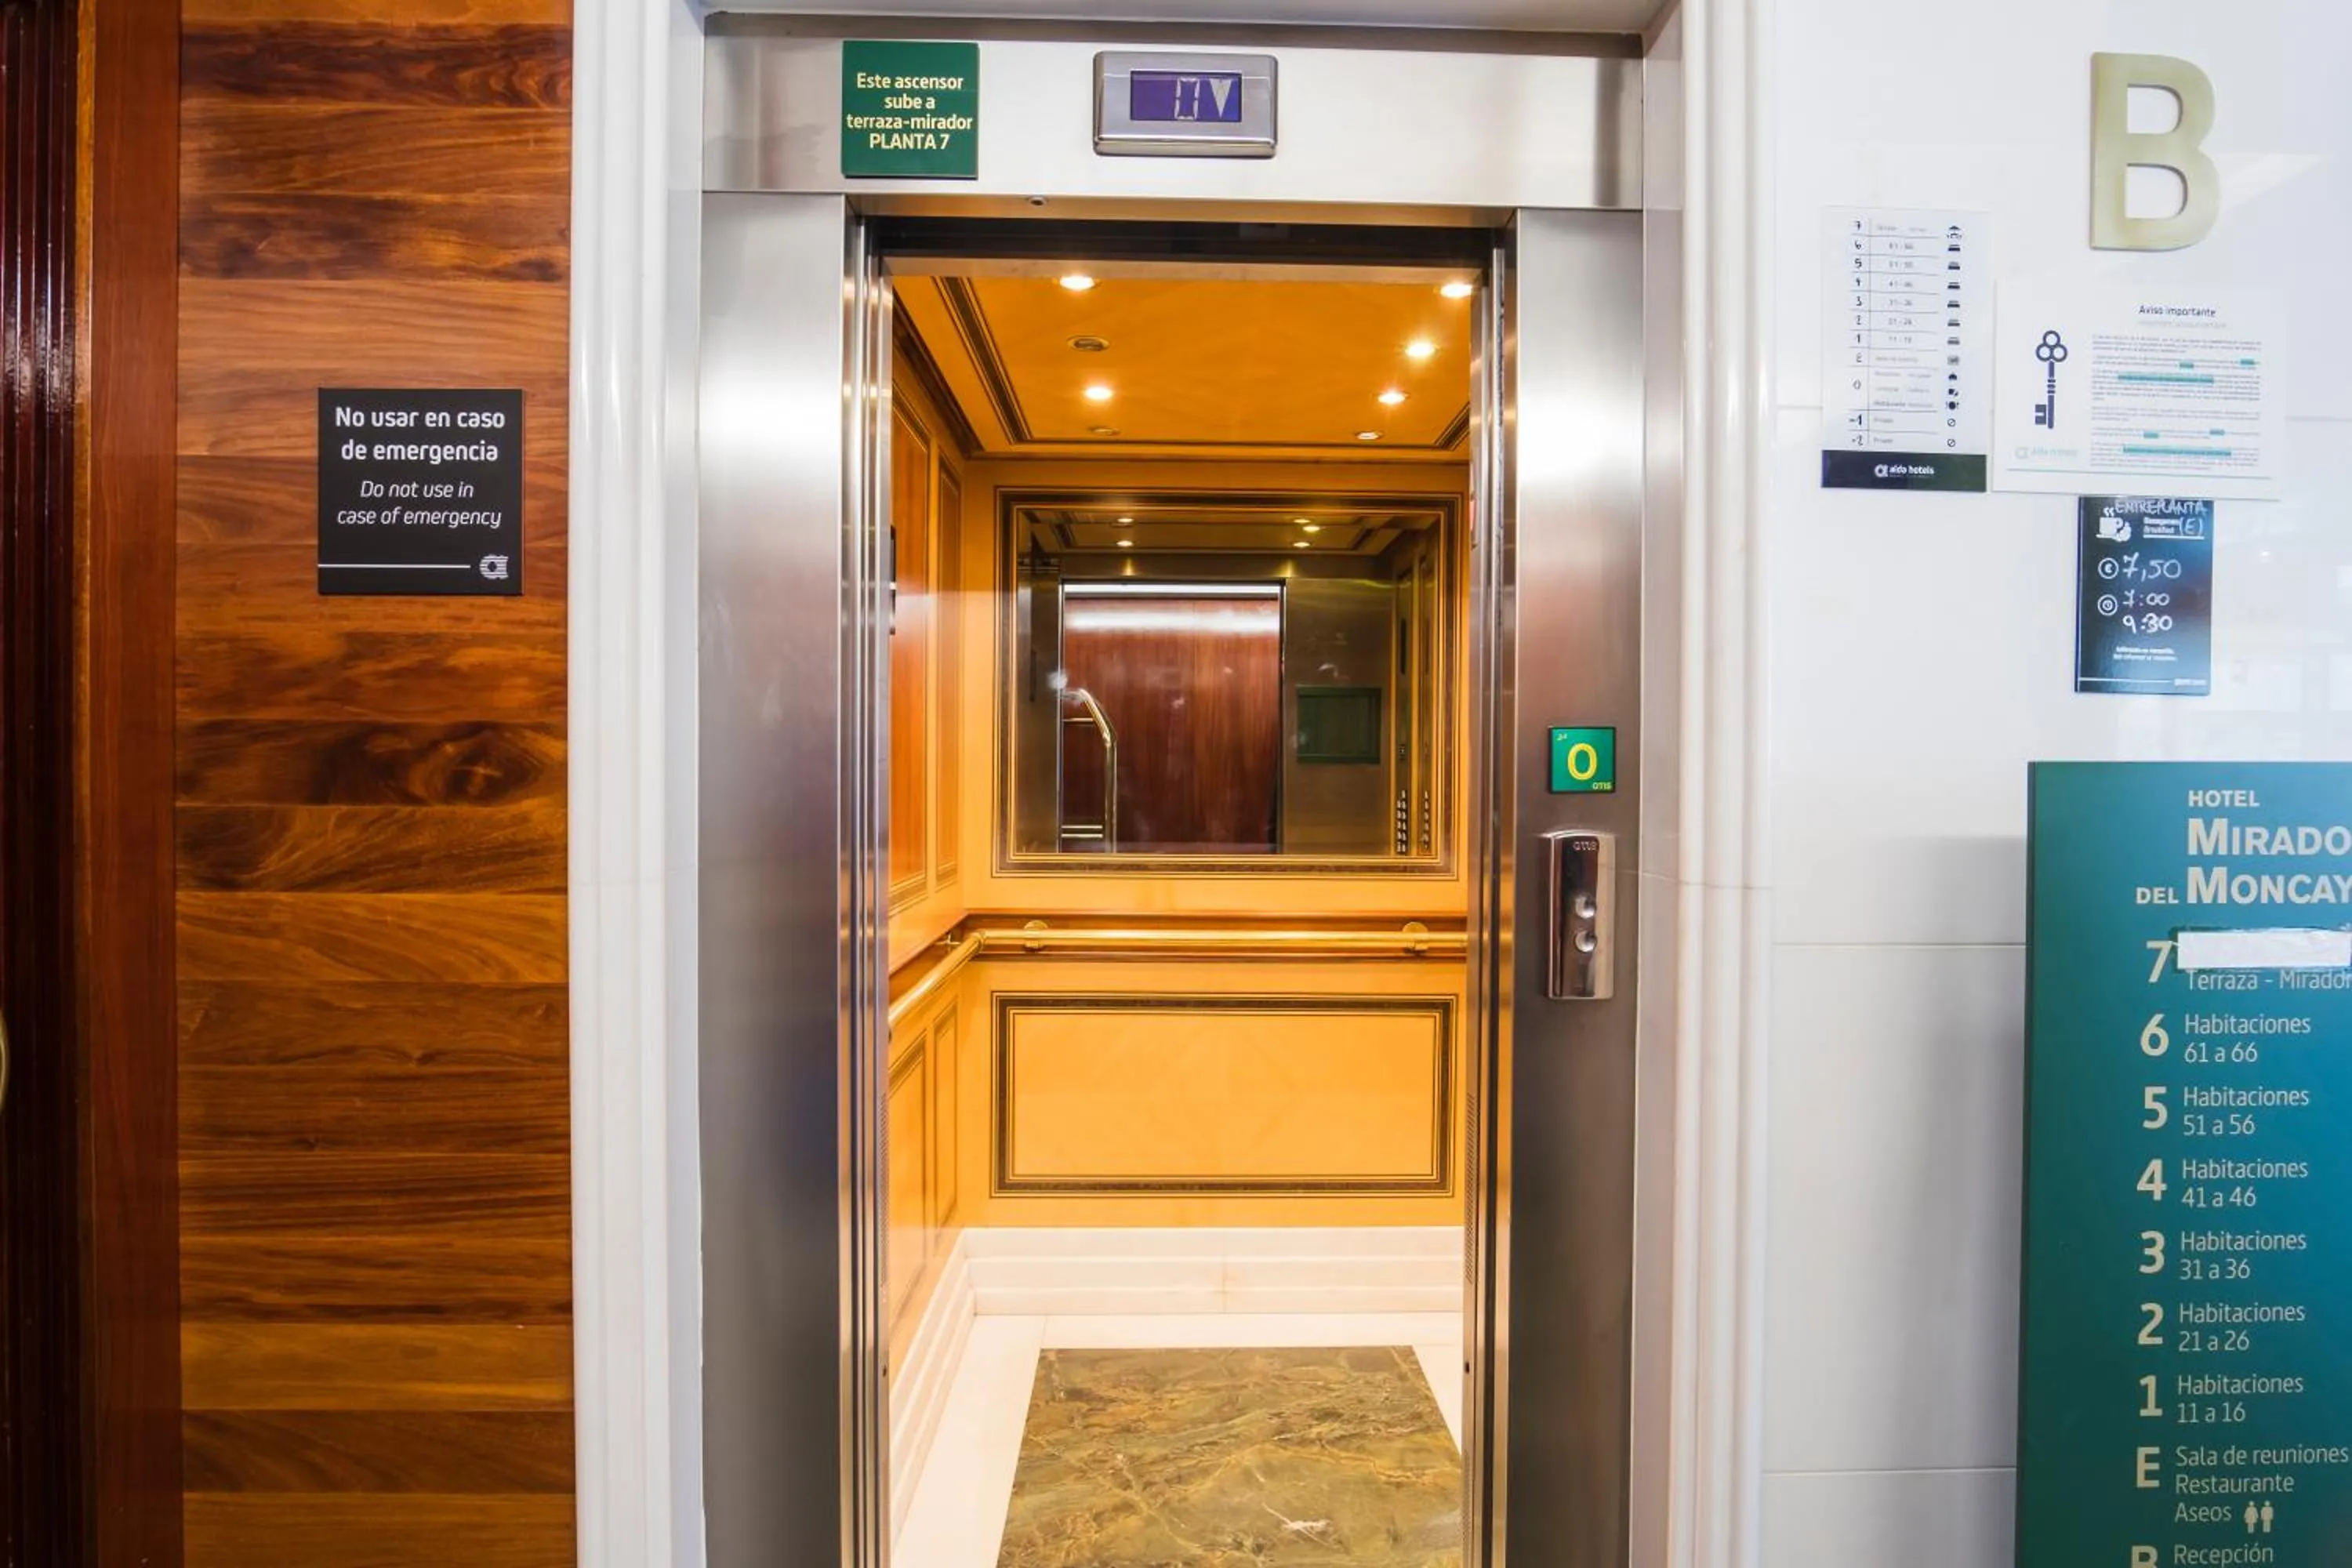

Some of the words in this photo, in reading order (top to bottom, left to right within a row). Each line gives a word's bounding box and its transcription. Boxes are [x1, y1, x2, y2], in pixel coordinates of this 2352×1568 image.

[857, 73, 891, 88] Este
[895, 78, 964, 89] ascensor
[884, 93, 922, 109] sube
[925, 96, 935, 109] a
[1174, 77, 1200, 121] 0
[847, 114, 973, 129] terraza-mirador
[869, 133, 936, 149] PLANTA
[940, 134, 950, 150] 7
[2089, 52, 2220, 252] B
[1855, 240, 1862, 250] 6
[1855, 259, 1862, 269] 5
[1856, 296, 1862, 307] 3
[2140, 305, 2164, 315] Aviso
[1856, 315, 1861, 325] 2
[335, 407, 365, 427] No
[371, 412, 419, 427] usar
[424, 412, 450, 427] en
[457, 412, 506, 428] caso
[341, 439, 367, 460] de
[372, 439, 499, 464] emergencia
[361, 481, 384, 498] Do
[388, 481, 418, 498] not
[423, 484, 454, 498] use
[458, 481, 474, 498] in
[337, 510, 376, 524] case
[381, 506, 401, 524] of
[403, 510, 502, 528] emergency
[2122, 552, 2182, 582] 7,50
[2122, 589, 2170, 608] 7:00
[2188, 790, 2260, 808] HOTEL
[2136, 887, 2179, 904] DEL
[2187, 867, 2352, 904] MONCAY
[2146, 940, 2172, 982] 7
[2186, 968, 2258, 991] Terraza
[2140, 1014, 2169, 1056] 6
[2185, 1014, 2311, 1034] Habitaciones
[2184, 1042, 2208, 1063] 61
[2215, 1047, 2225, 1062] a
[2231, 1041, 2258, 1062] 66
[2142, 1086, 2168, 1129] 5
[2183, 1086, 2309, 1106] Habitaciones
[2183, 1114, 2206, 1136] 51
[2212, 1120, 2223, 1134] a
[2229, 1114, 2256, 1134] 56
[2136, 1158, 2167, 1201] 4
[2182, 1158, 2308, 1178] Habitaciones
[2182, 1187, 2206, 1208] 41
[2212, 1192, 2223, 1207] a
[2229, 1186, 2256, 1207] 46
[2139, 1230, 2165, 1274] 3
[2180, 1230, 2307, 1251] Habitaciones
[2180, 1259, 2203, 1280] 31
[2209, 1264, 2219, 1279] a
[2225, 1258, 2250, 1279] 36
[2137, 1302, 2164, 1345] 2
[2179, 1302, 2306, 1323] Habitaciones
[2178, 1330, 2201, 1352] 21
[2208, 1336, 2218, 1351] a
[2224, 1330, 2249, 1351] 26
[2140, 1375, 2162, 1417] 1
[2177, 1374, 2303, 1395] Habitaciones
[2177, 1403, 2199, 1423] 11
[2205, 1407, 2216, 1422] a
[2222, 1402, 2246, 1421] 16
[2136, 1446, 2160, 1488] E
[2176, 1446, 2217, 1466] Sala
[2223, 1446, 2247, 1465] de
[2252, 1443, 2349, 1465] reuniones
[2176, 1474, 2294, 1494] Restaurante
[2175, 1502, 2232, 1523] Aseos
[2174, 1541, 2273, 1567] Recepción
